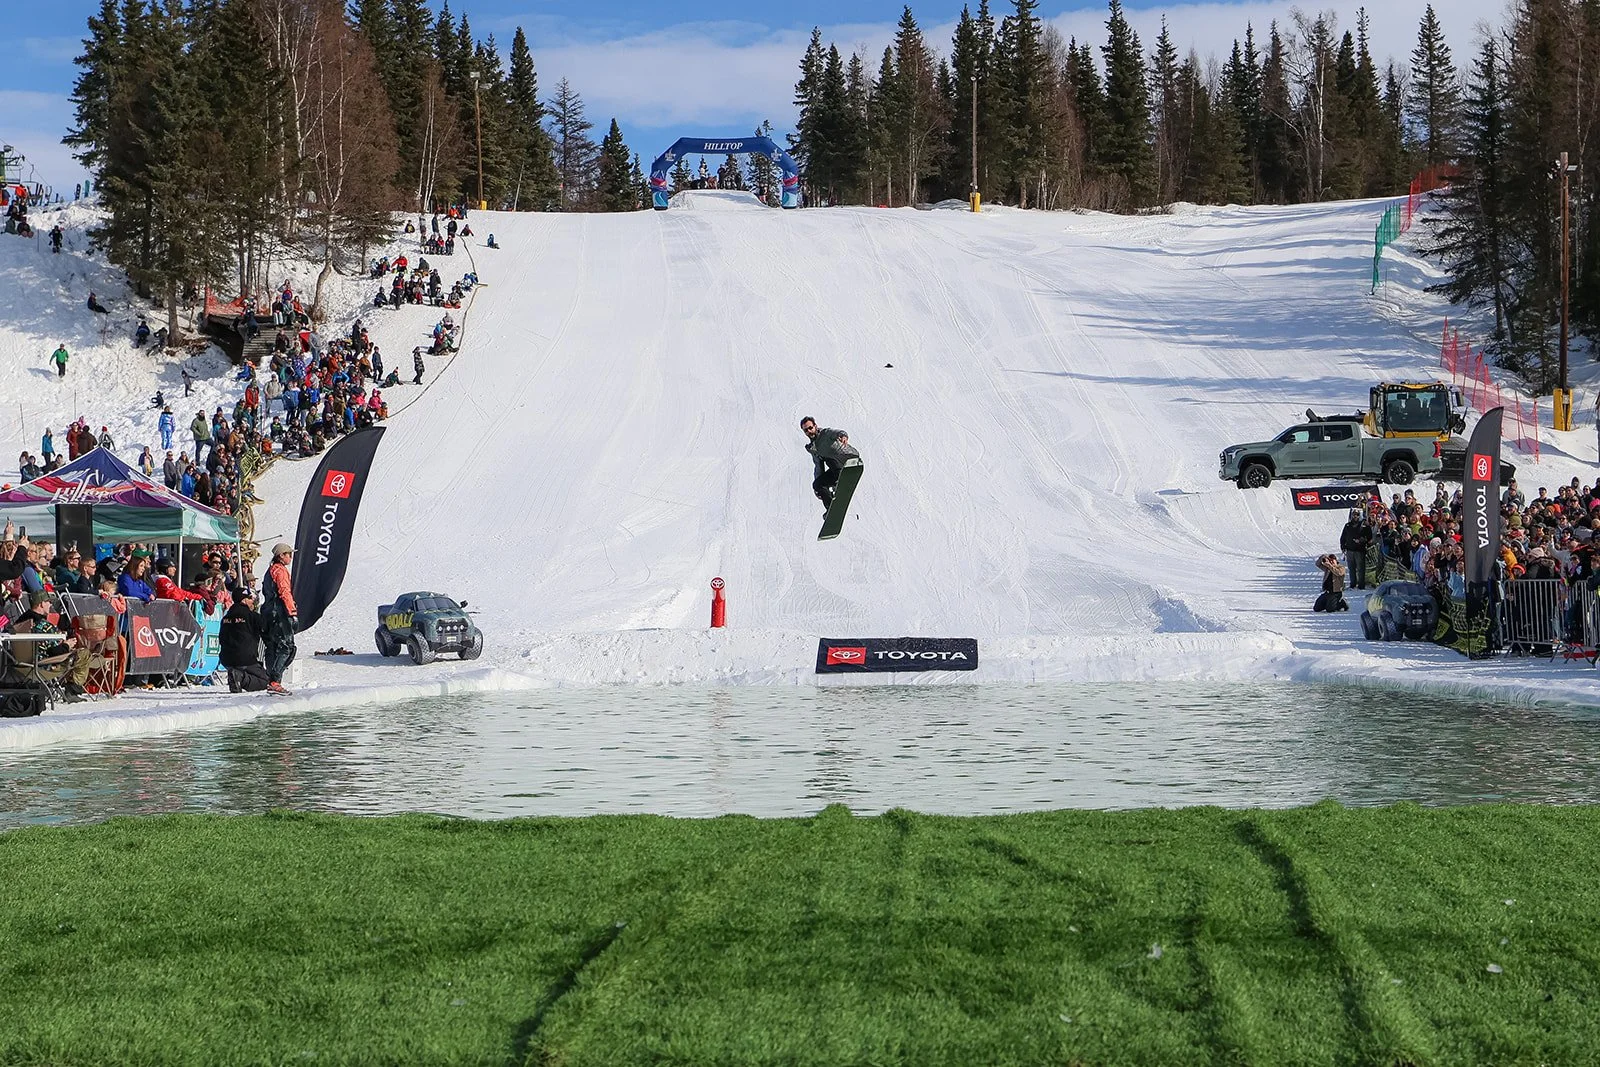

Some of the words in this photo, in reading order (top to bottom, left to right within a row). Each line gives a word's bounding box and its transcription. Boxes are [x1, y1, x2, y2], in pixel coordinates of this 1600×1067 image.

[704, 142, 744, 150] HILLTOP
[1322, 493, 1363, 502] TOYO
[1477, 485, 1490, 549] TOYOTA
[315, 502, 339, 565] TOYOTA
[873, 650, 967, 660] TOYOTA
